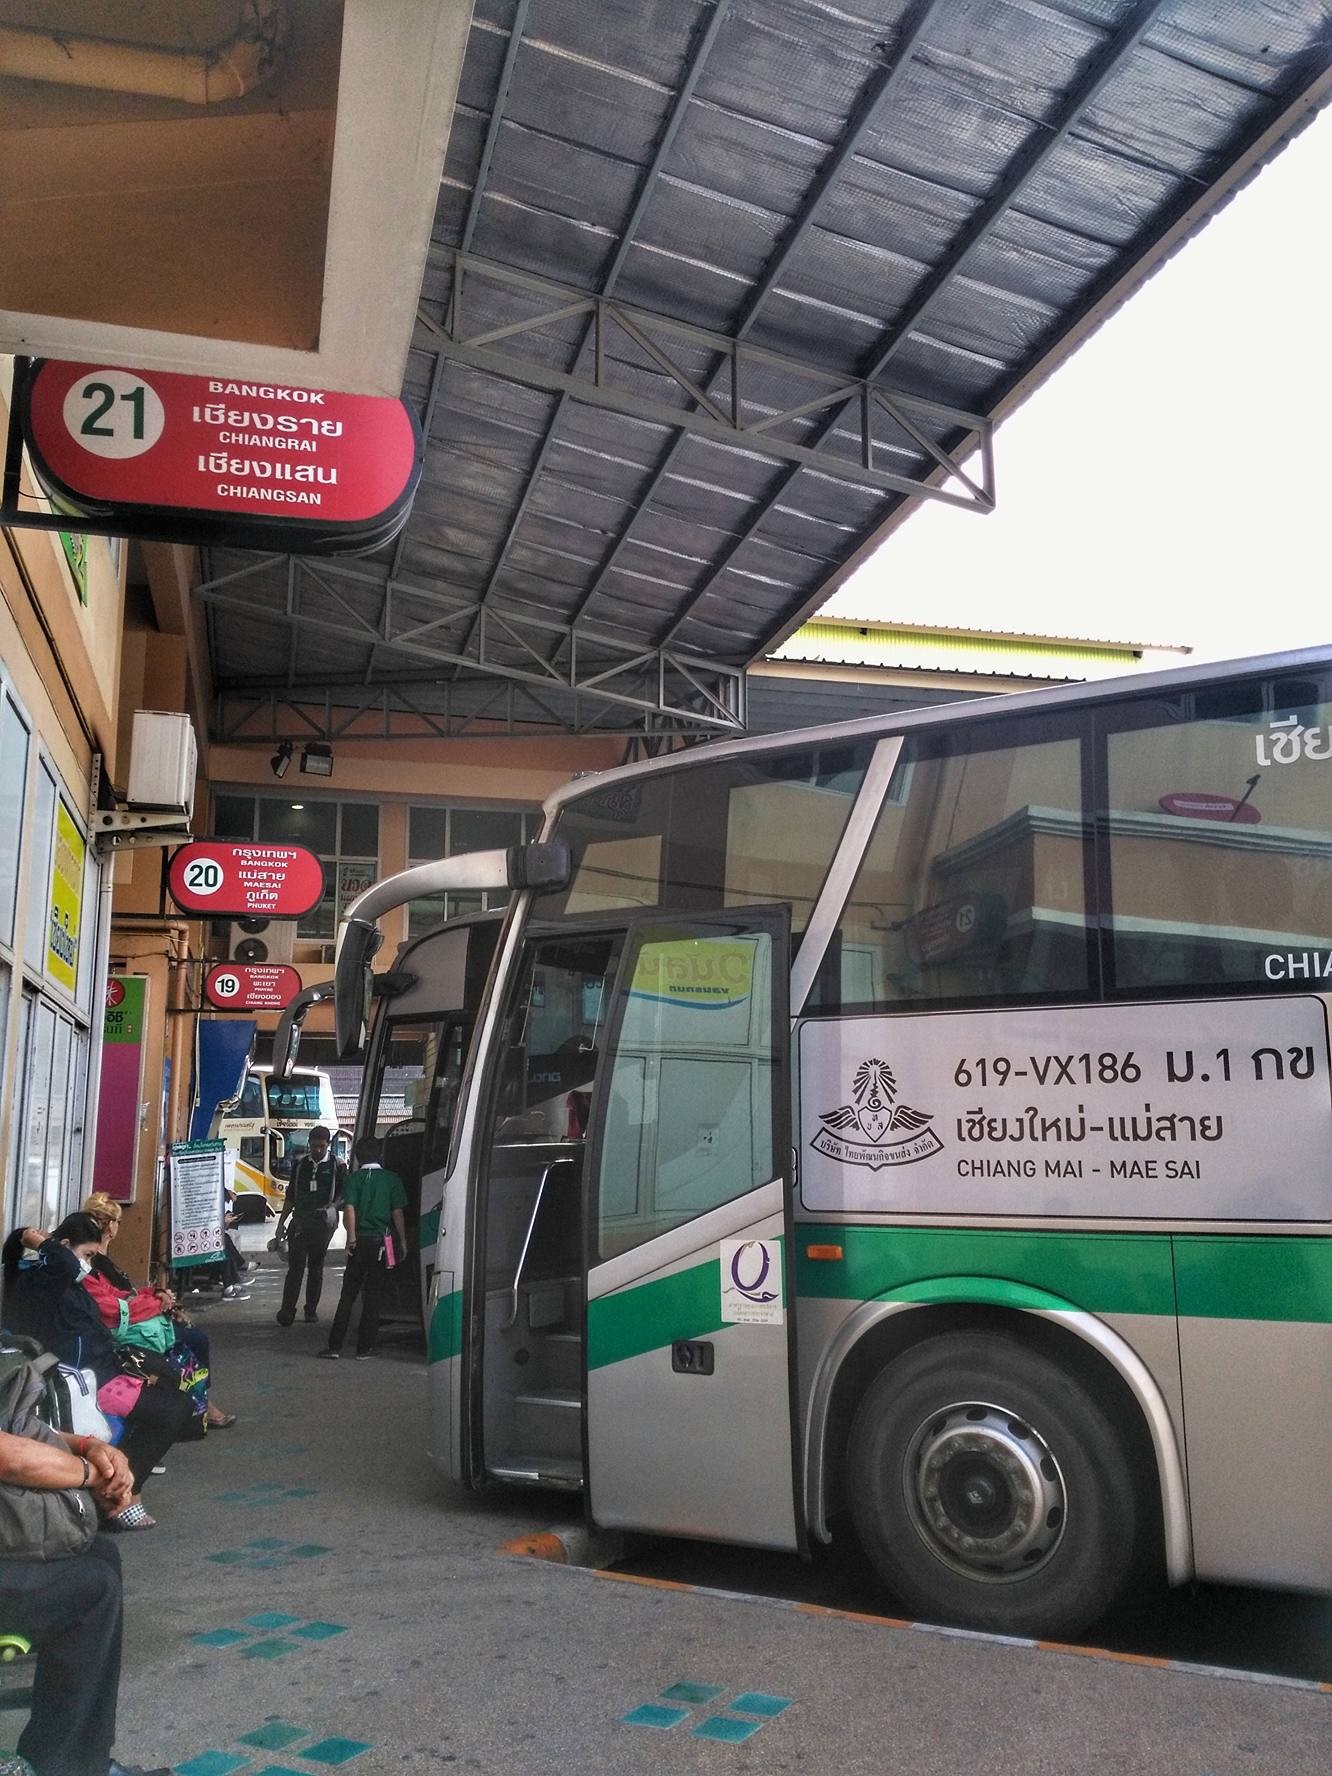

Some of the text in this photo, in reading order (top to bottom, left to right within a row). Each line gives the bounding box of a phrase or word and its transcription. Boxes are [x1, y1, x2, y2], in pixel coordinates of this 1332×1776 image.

[208, 381, 325, 405] BANGKOK
[80, 382, 144, 440] 21
[192, 403, 343, 437] เชียงราย
[218, 431, 317, 452] CHIANGRAI
[198, 452, 338, 485] เชียงแสน
[217, 484, 321, 505] CHIANGSAN
[1256, 714, 1332, 767] เชีย
[232, 848, 297, 860] กรุงเทพฯ
[240, 859, 288, 868] BANGKOK
[188, 864, 219, 887] 20
[238, 869, 286, 881] แม่สาย
[243, 881, 281, 889] MAESAI
[246, 889, 279, 902] ภูเก็ต
[244, 967, 285, 975] กรุงเทพฯ
[217, 978, 236, 993] 19
[955, 1047, 1315, 1088] 619-VX186 ม.1 กข
[956, 1103, 1223, 1143] เชียงใหม่-แม่สาย
[820, 1139, 842, 1156] บริษัท
[913, 1138, 935, 1155] จำกัด
[957, 1159, 1036, 1178] CHIANG
[1045, 1159, 1083, 1179] MAI
[1109, 1159, 1158, 1179] MAE
[1164, 1159, 1200, 1180] SAI
